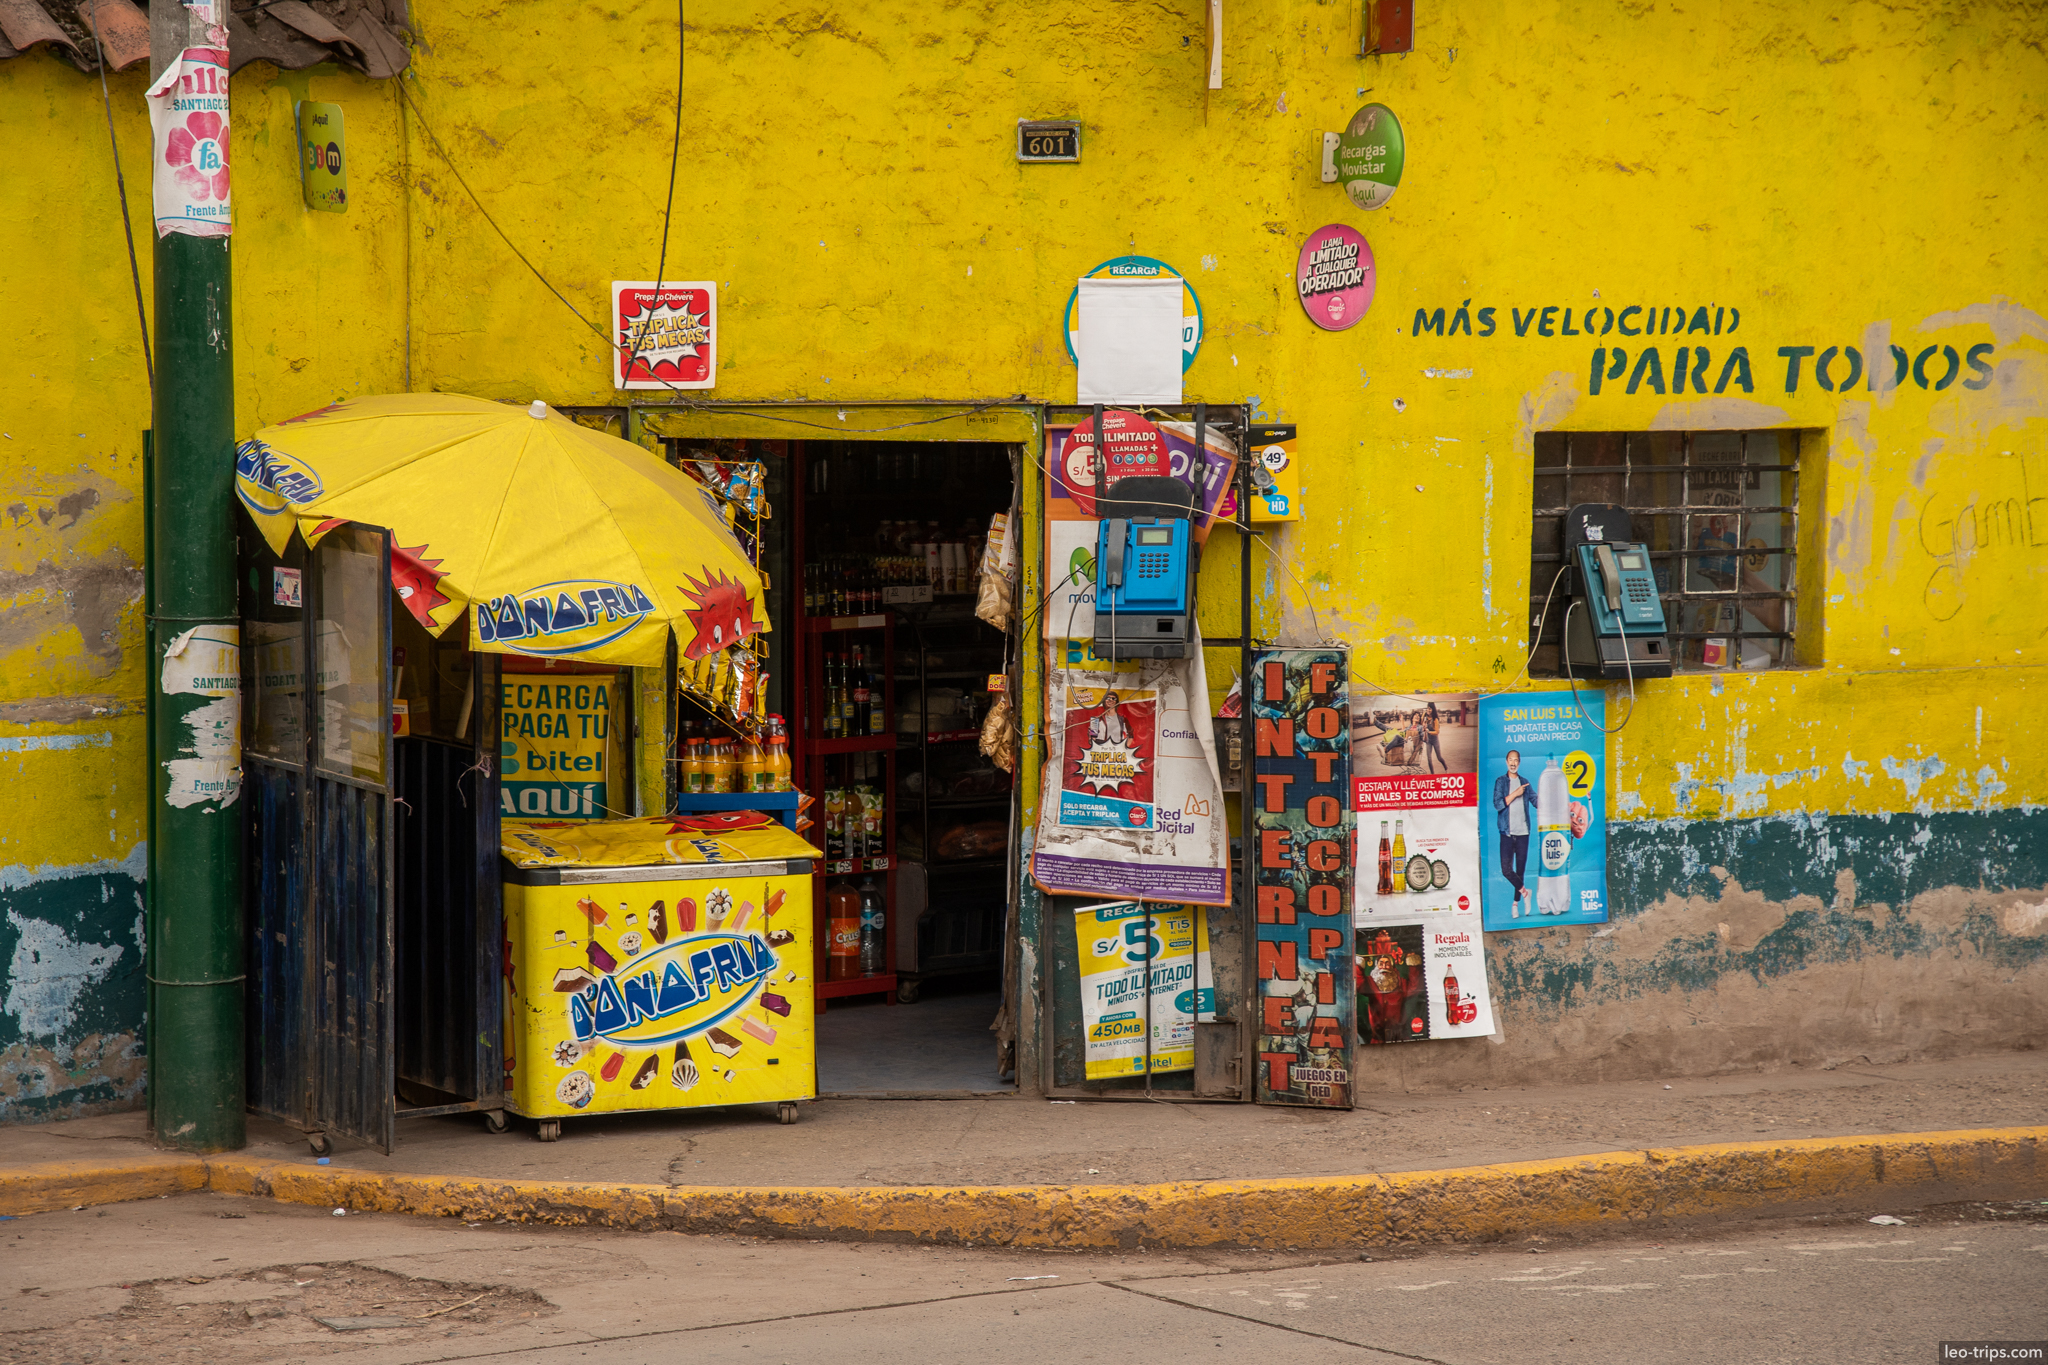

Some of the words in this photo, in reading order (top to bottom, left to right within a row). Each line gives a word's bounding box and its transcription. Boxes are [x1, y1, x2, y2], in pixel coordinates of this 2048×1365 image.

[173, 99, 223, 110] SANTIAGO
[1029, 136, 1065, 155] 601
[1341, 144, 1387, 161] Recargas
[198, 141, 222, 170] fa
[1341, 162, 1386, 178] Movistar
[1352, 184, 1377, 205] Aquí
[185, 205, 216, 216] Frente
[1321, 236, 1344, 249] LLAMA
[1309, 243, 1359, 266] ILIMITADO
[1112, 266, 1157, 275] RECARGA
[1306, 265, 1313, 278] A
[1314, 257, 1357, 276] CUALQUIER
[634, 293, 664, 302] Prepago
[664, 291, 694, 301] Chévere
[1412, 298, 1497, 337] MÁS
[1511, 304, 1740, 337] VELOCIDAD
[629, 315, 698, 336] TRIPLICA
[626, 336, 656, 352] TUS
[657, 329, 705, 350] MEGAS
[1589, 345, 1754, 396] PARA
[1777, 343, 1995, 394] TODOS
[1074, 433, 1094, 443] TOD
[1103, 432, 1157, 443] ILIMITADO
[1111, 445, 1148, 453] LLAMADAS
[1722, 450, 1742, 461] GLORI
[1166, 449, 1226, 491] QUÍ
[1271, 500, 1286, 512] HD
[193, 676, 237, 689] SANTIAGO
[502, 684, 609, 710] ECARGA
[1503, 708, 1528, 721] SAN
[1531, 707, 1556, 720] LUIS
[1558, 706, 1573, 719] 1.5
[1575, 706, 1583, 718] L
[504, 713, 570, 739] PAGA
[577, 714, 609, 740] TU
[1503, 722, 1547, 733] HIDRÁTATE
[1548, 723, 1560, 732] EN
[1560, 721, 1583, 731] CASA
[1506, 735, 1513, 743] A
[1513, 734, 1526, 743] UN
[1527, 733, 1551, 742] GRAN
[1551, 731, 1581, 741] PRECIO
[527, 750, 602, 772] bitel
[1090, 751, 1127, 763] TRIPLICA
[1081, 763, 1100, 776] TUS
[1101, 763, 1135, 778] MEGAS
[194, 779, 224, 791] Frente
[1358, 781, 1393, 792] DESTAPA
[1393, 781, 1399, 790] Y
[1400, 778, 1436, 790] LLÉVATE
[1359, 793, 1372, 803] EN
[1372, 792, 1401, 803] VALES
[1405, 791, 1419, 801] DE
[1420, 789, 1465, 801] COMPRAS
[1063, 809, 1085, 818] ACEPTA
[1092, 811, 1120, 819] TRIPLICA
[1079, 803, 1107, 811] RECARGA
[1156, 808, 1181, 821] Red
[1155, 821, 1195, 834] Digital
[1545, 839, 1562, 848] san
[1306, 663, 1345, 1049] FOTOCOPIA
[1546, 848, 1561, 860] luis
[1256, 662, 1298, 1091] INTERNET
[1581, 889, 1599, 899] san
[1582, 899, 1598, 911] luis
[1166, 919, 1191, 930] Ti5
[1435, 931, 1470, 946] Regala
[1438, 945, 1468, 953] MOMENTOS
[1096, 979, 1128, 1000] TODO
[1130, 963, 1193, 992] ILIMITADO
[1150, 982, 1180, 996] NTERNET
[1093, 1022, 1141, 1038] 450MB
[1295, 1068, 1332, 1082] JUEGOS
[1333, 1069, 1347, 1083] EN
[1310, 1085, 1331, 1098] RED
